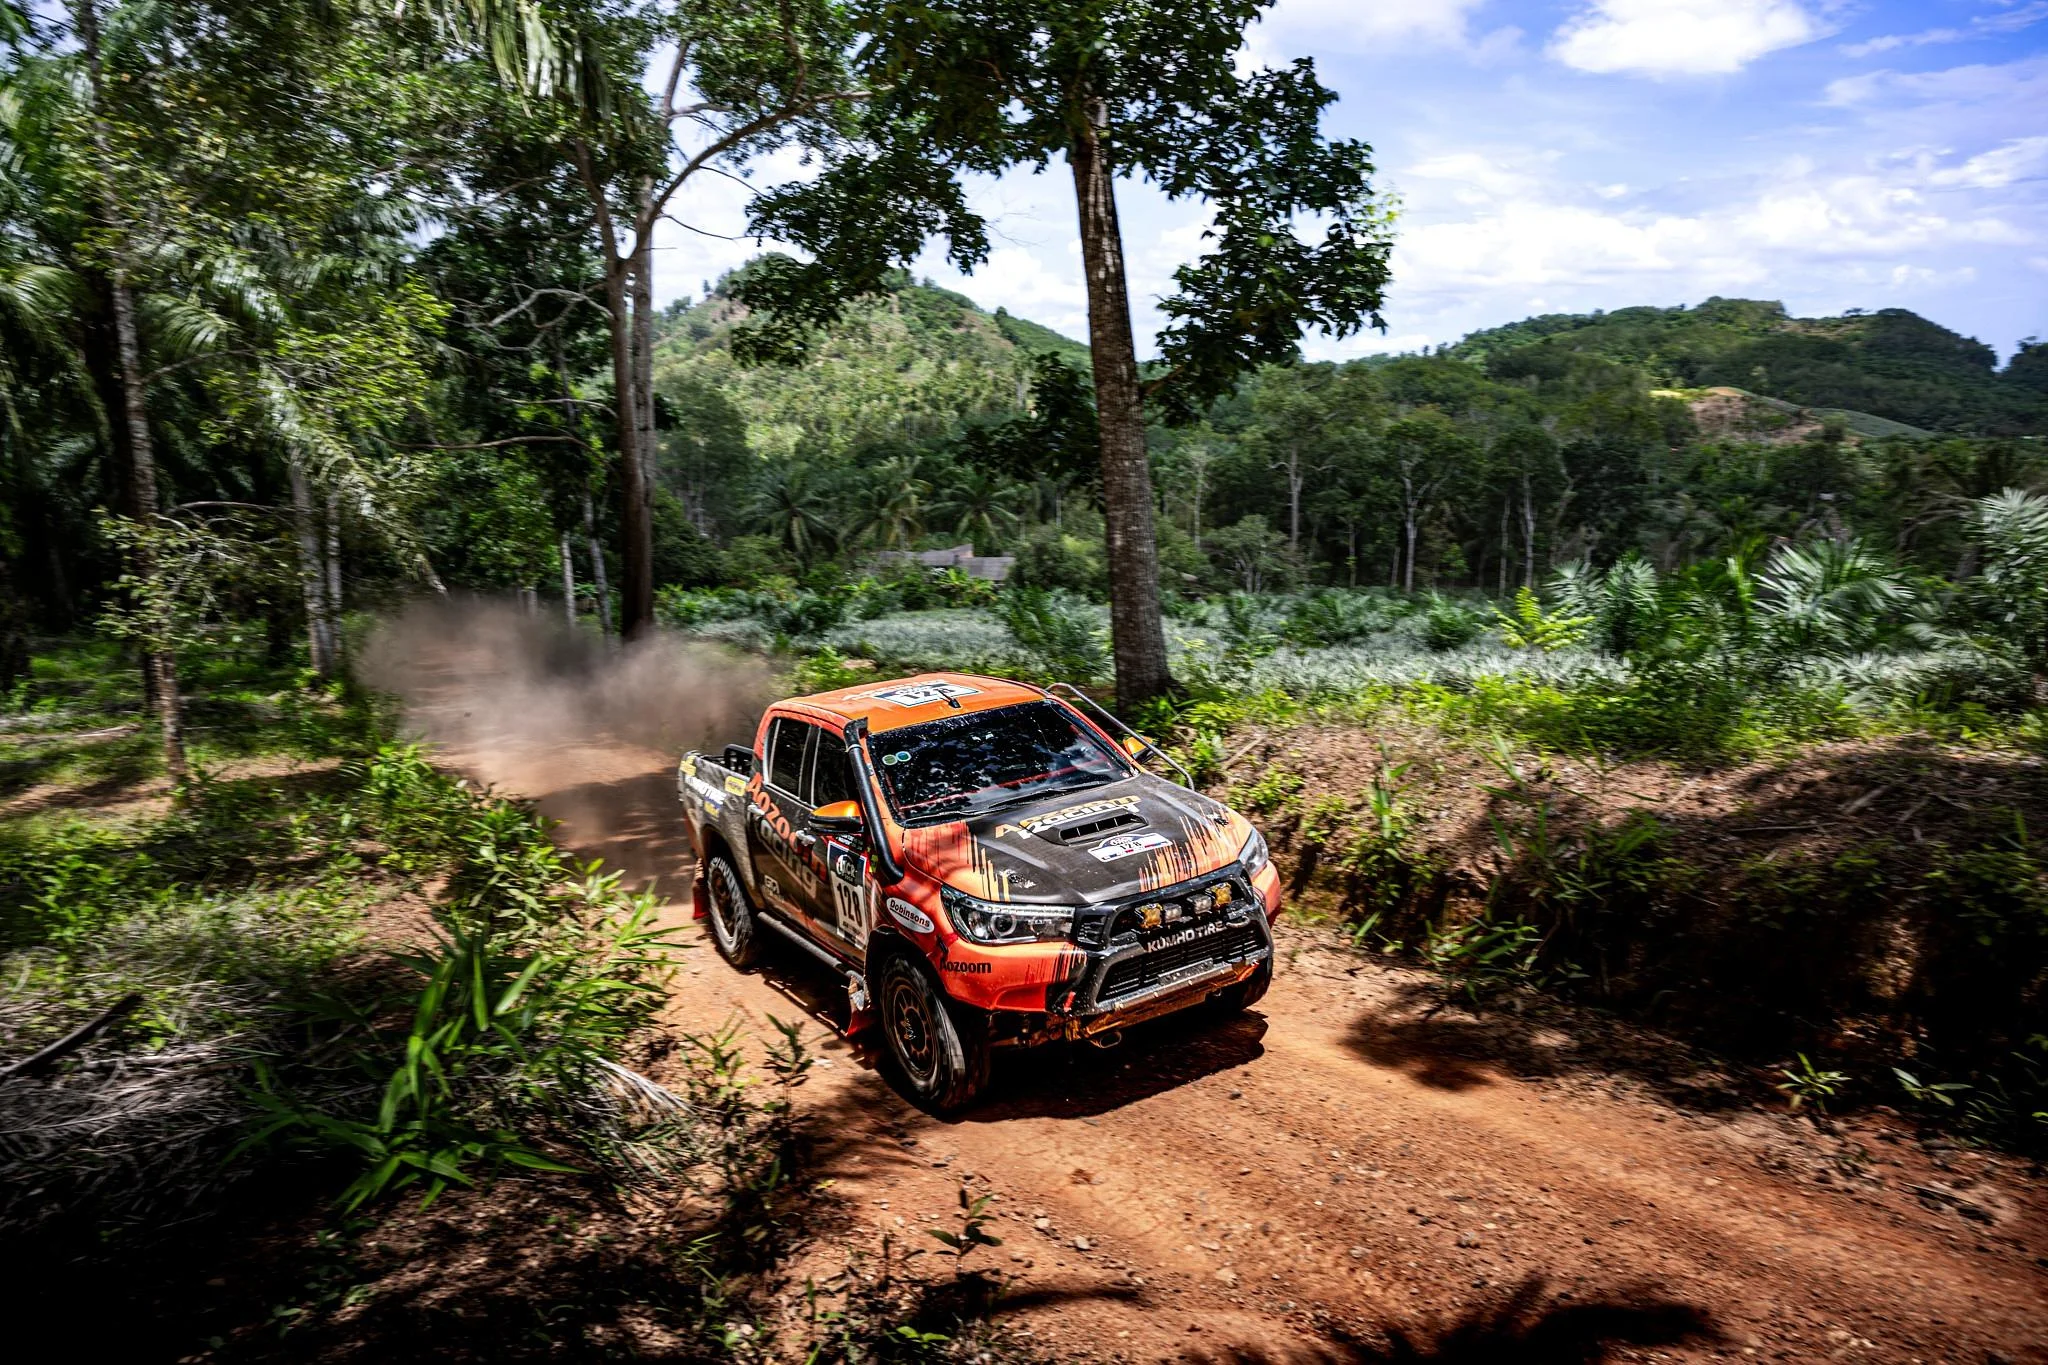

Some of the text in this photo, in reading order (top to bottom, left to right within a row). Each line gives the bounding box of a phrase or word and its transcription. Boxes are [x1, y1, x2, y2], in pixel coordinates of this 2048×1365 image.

[837, 883, 862, 927] 128
[890, 899, 930, 928] Dobinsons
[1147, 921, 1228, 952] KUMHO TIRE
